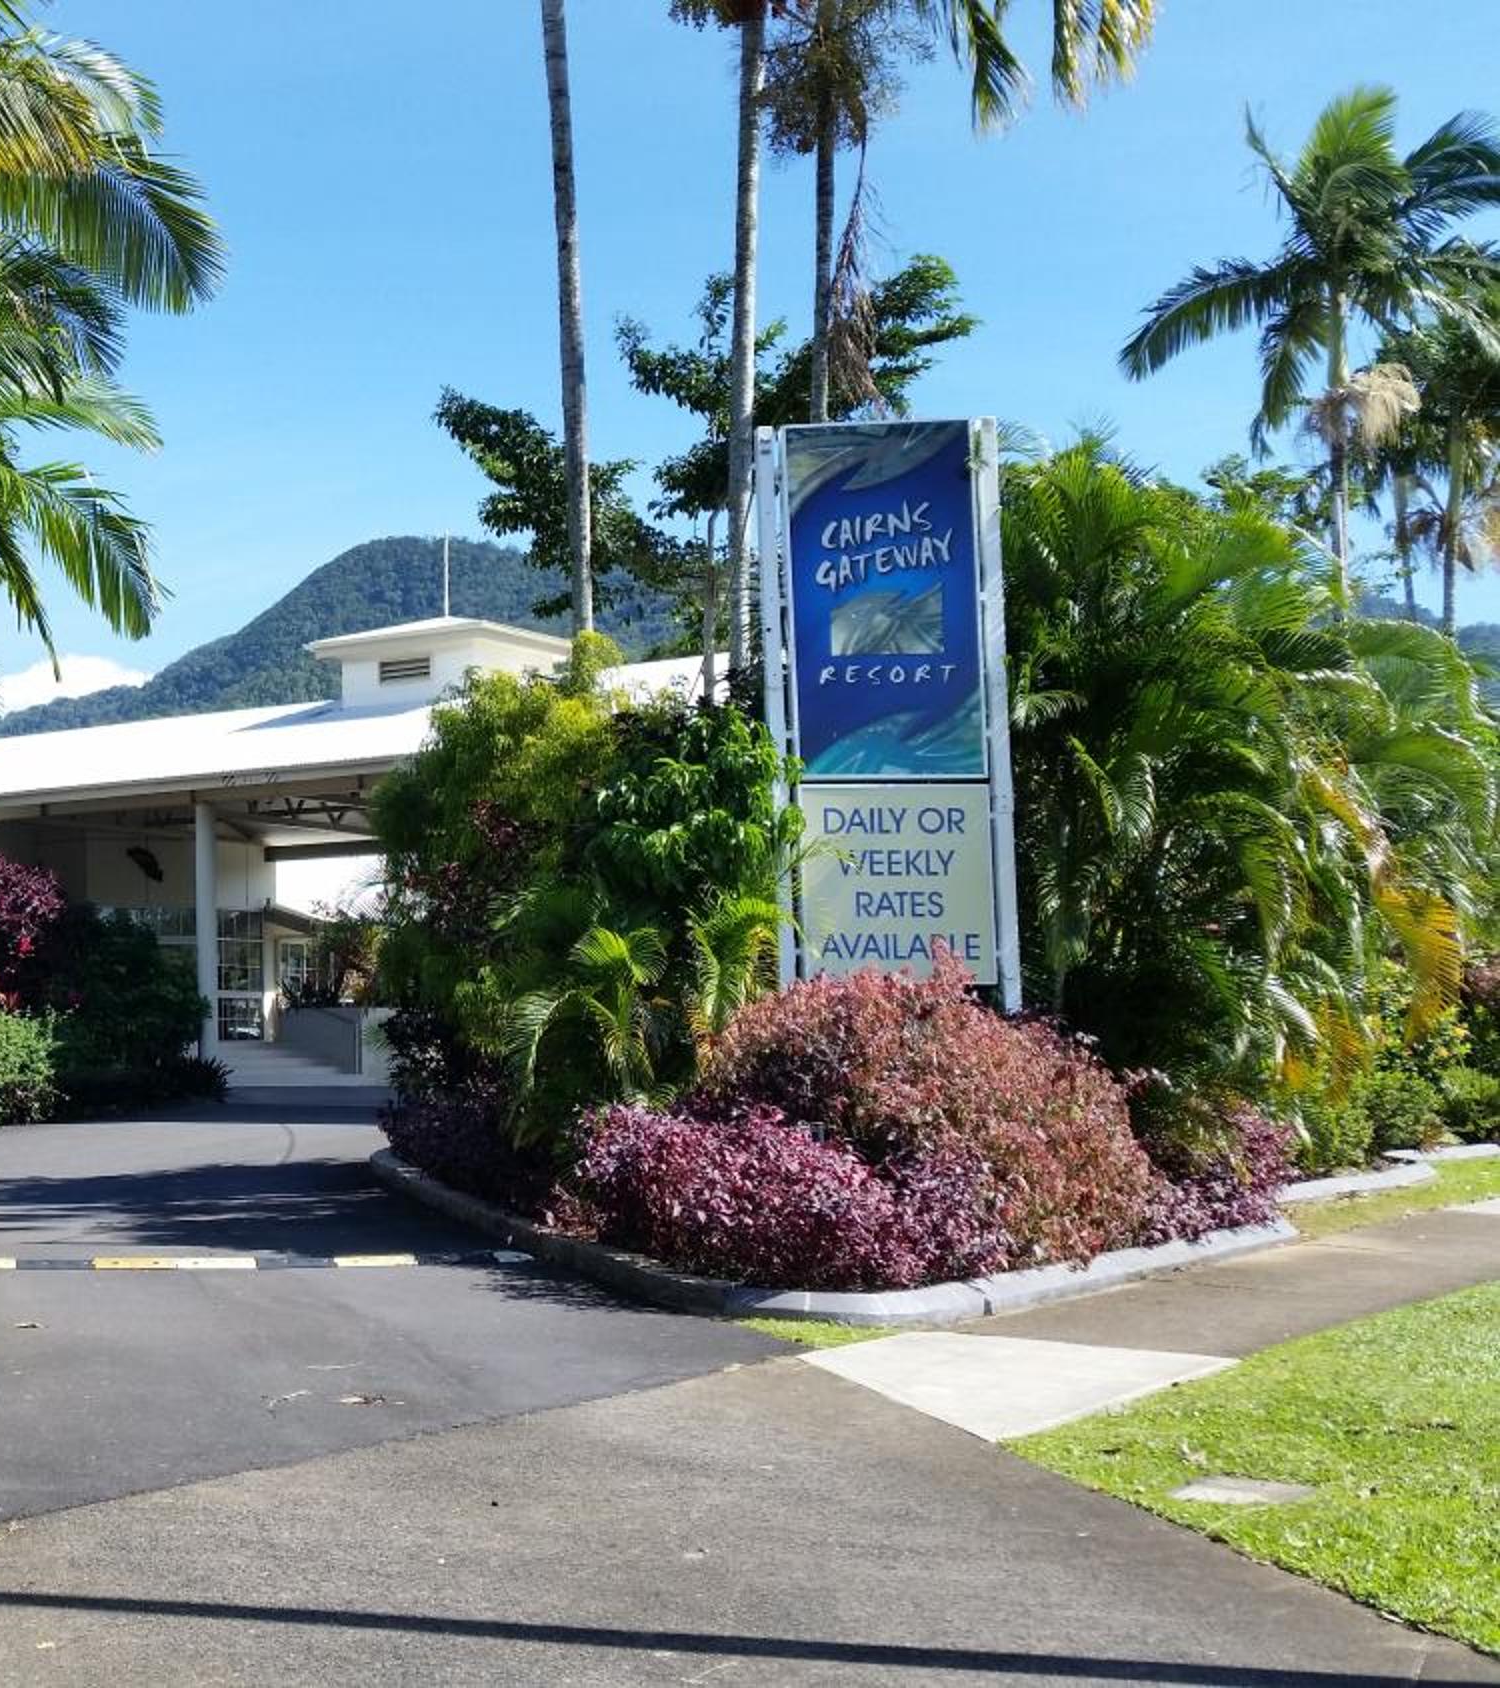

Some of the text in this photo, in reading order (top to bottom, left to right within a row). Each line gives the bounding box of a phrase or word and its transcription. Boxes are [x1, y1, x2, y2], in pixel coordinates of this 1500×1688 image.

[820, 501, 933, 549] CAIRNS
[815, 528, 953, 593] GATEWAY
[819, 665, 956, 685] RESORT
[823, 807, 965, 834] DAILY OR
[855, 891, 944, 918] RATES
